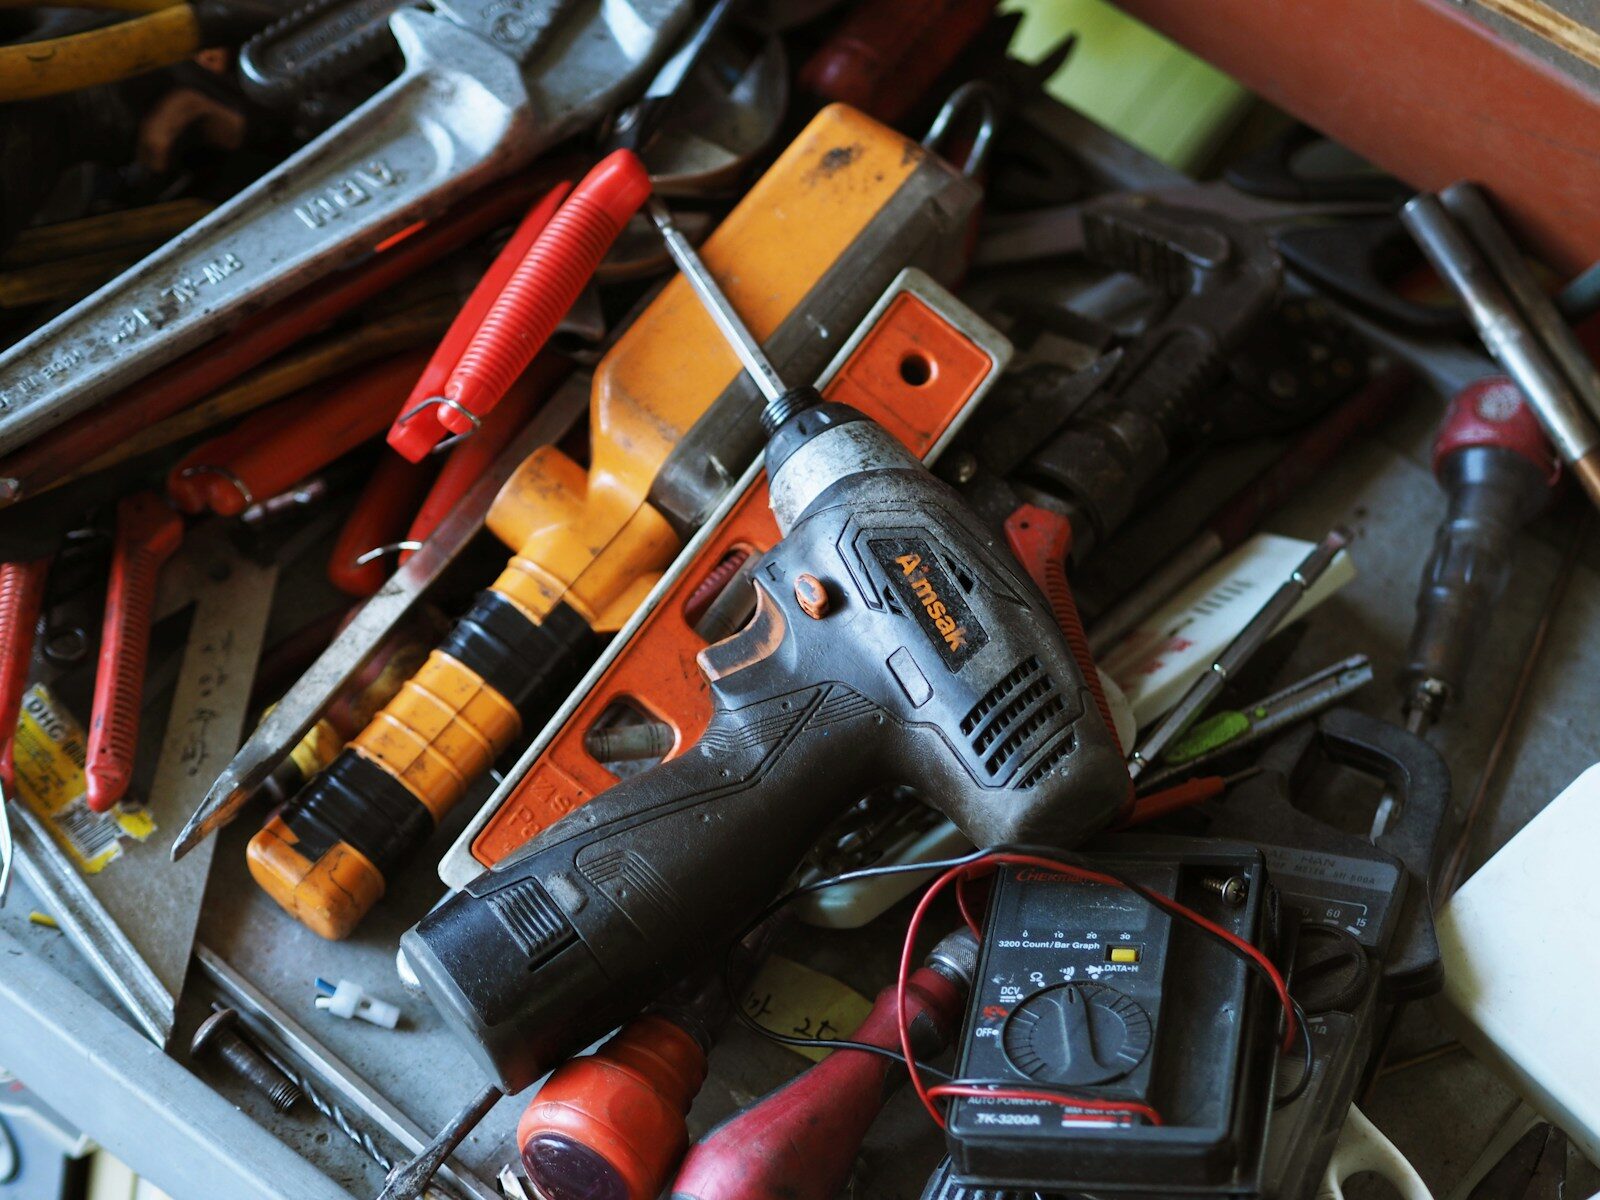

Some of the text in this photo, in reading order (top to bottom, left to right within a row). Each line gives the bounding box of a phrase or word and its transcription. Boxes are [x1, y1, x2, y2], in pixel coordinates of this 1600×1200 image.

[1326, 908, 1341, 919] 60
[1356, 918, 1367, 928] 15
[1086, 932, 1098, 940] 20
[1119, 933, 1131, 941] 30
[998, 940, 1100, 951] 3200 Count/Bar Graph
[1000, 986, 1021, 996] DCV
[975, 1028, 993, 1038] OFF
[968, 1097, 996, 1106] AUTO
